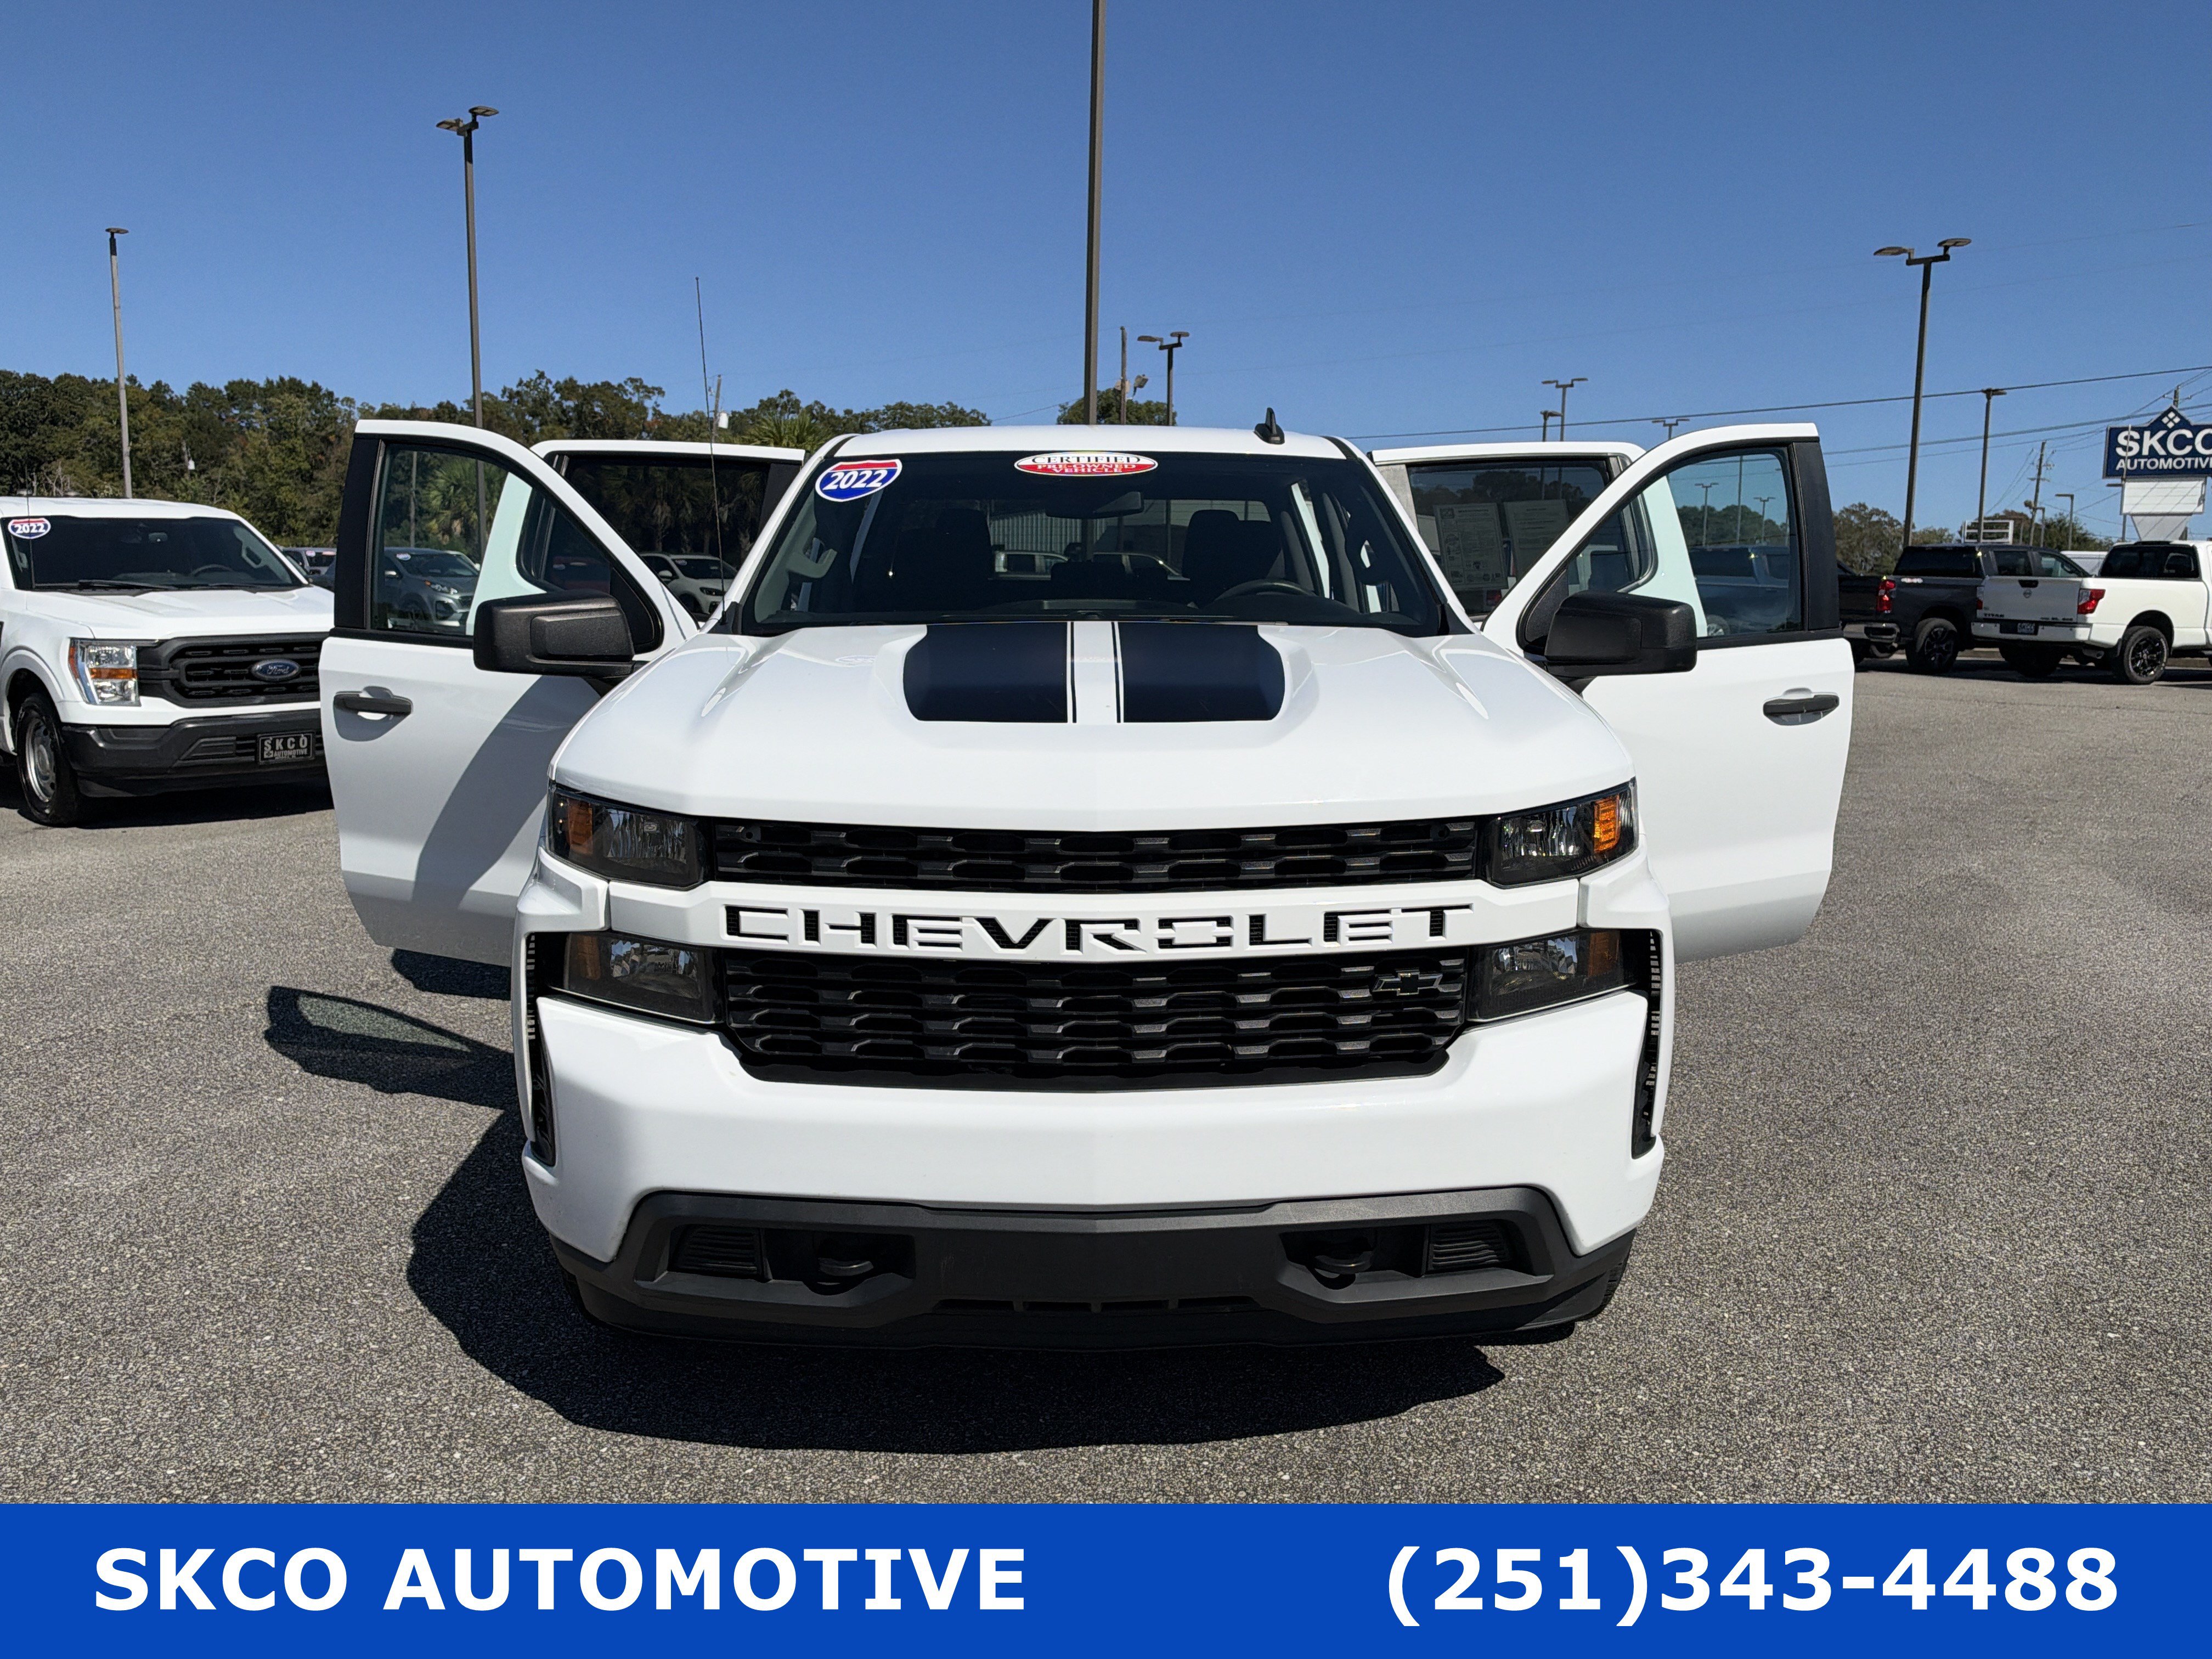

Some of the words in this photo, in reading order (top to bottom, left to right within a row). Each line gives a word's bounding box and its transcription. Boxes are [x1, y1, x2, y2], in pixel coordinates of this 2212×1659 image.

[2115, 457, 2212, 471] AUTOMOTIV
[822, 470, 888, 490] 2022
[14, 523, 46, 533] 2022
[267, 664, 290, 675] Ford
[264, 736, 307, 751] SKCO
[274, 748, 308, 757] AUTOMOTIVE
[724, 904, 1474, 951] CHEVROLET
